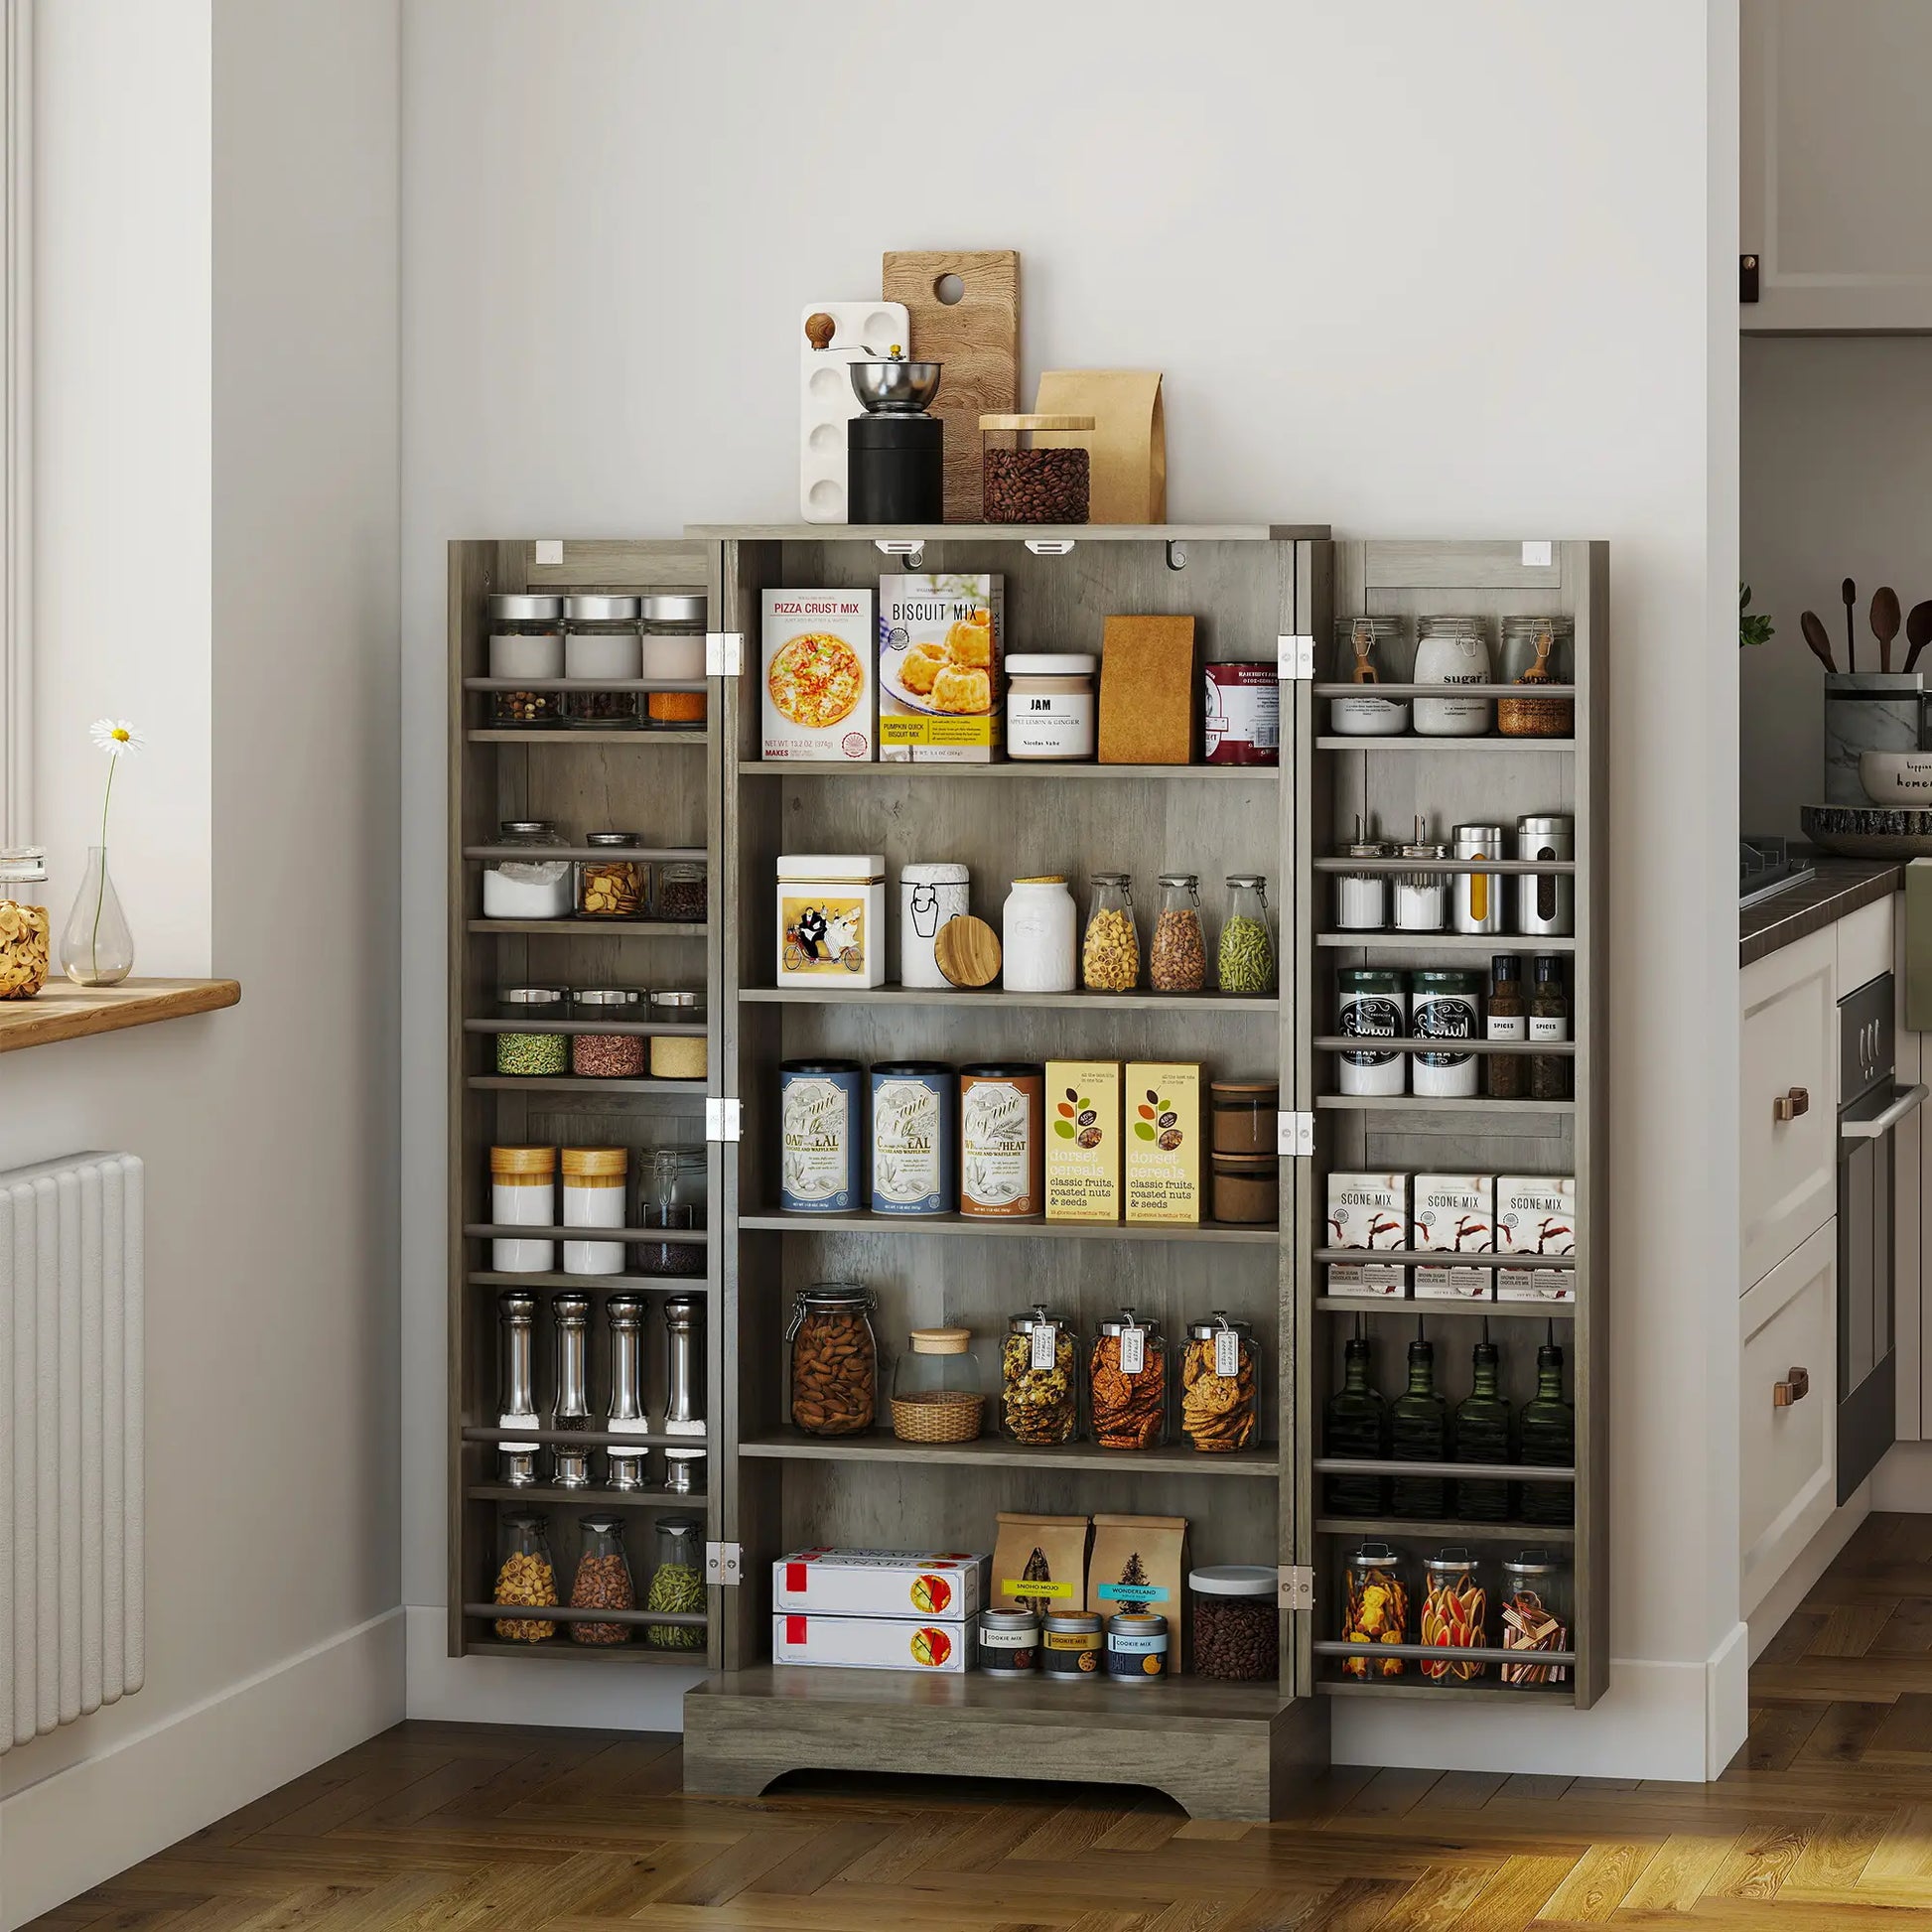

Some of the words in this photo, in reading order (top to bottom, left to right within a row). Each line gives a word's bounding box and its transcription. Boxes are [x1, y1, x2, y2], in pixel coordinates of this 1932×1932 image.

[774, 603, 802, 614] PIZZA
[804, 603, 838, 614] CRUST
[840, 603, 859, 614] MIX
[893, 604, 946, 621] BISCUIT
[953, 604, 977, 621] MIX
[1031, 699, 1051, 711] JAM
[1050, 1164, 1104, 1176] cereals
[1130, 1167, 1185, 1178] cereals
[1050, 1177, 1082, 1186] classic
[1131, 1179, 1164, 1188] classic
[1341, 1193, 1371, 1205] SCONE
[1374, 1194, 1392, 1205] MIX
[1428, 1195, 1457, 1207] SCONE
[1461, 1196, 1479, 1208] MIX
[1511, 1197, 1541, 1209] SCONE
[1545, 1198, 1562, 1210] MIX
